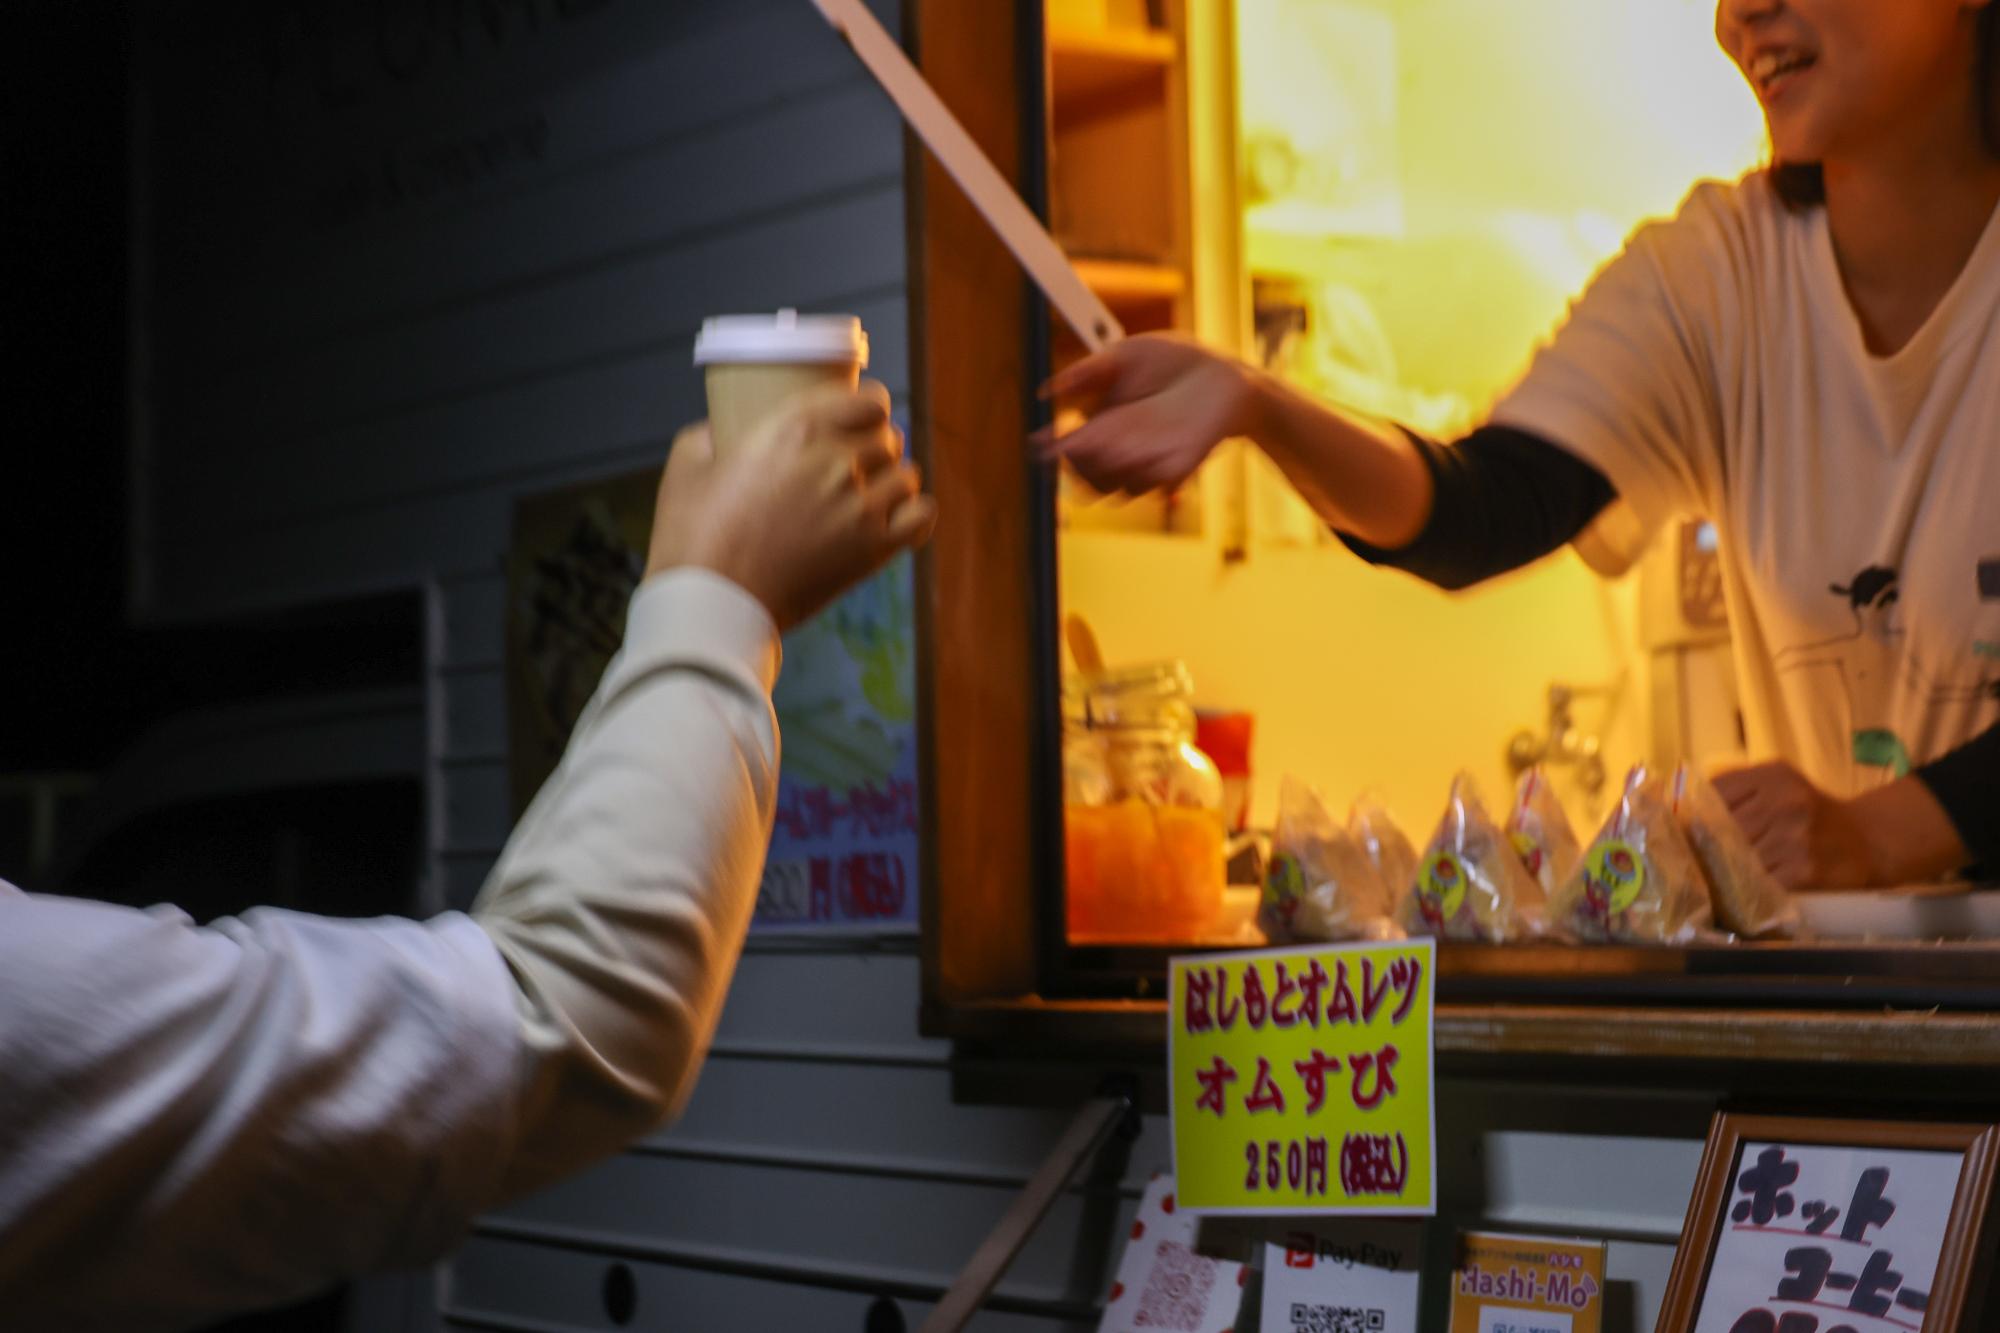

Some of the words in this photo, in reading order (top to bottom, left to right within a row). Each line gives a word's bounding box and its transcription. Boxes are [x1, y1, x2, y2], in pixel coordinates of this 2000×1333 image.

[1186, 956, 1421, 1033] はしもとオムレツ
[1195, 1043, 1400, 1117] オムすび
[1731, 1143, 1896, 1242] ホット
[1319, 1237, 1403, 1271] PayPay
[1461, 1264, 1587, 1307] Hashi-Mo
[1777, 1246, 1930, 1318] コーヒー
